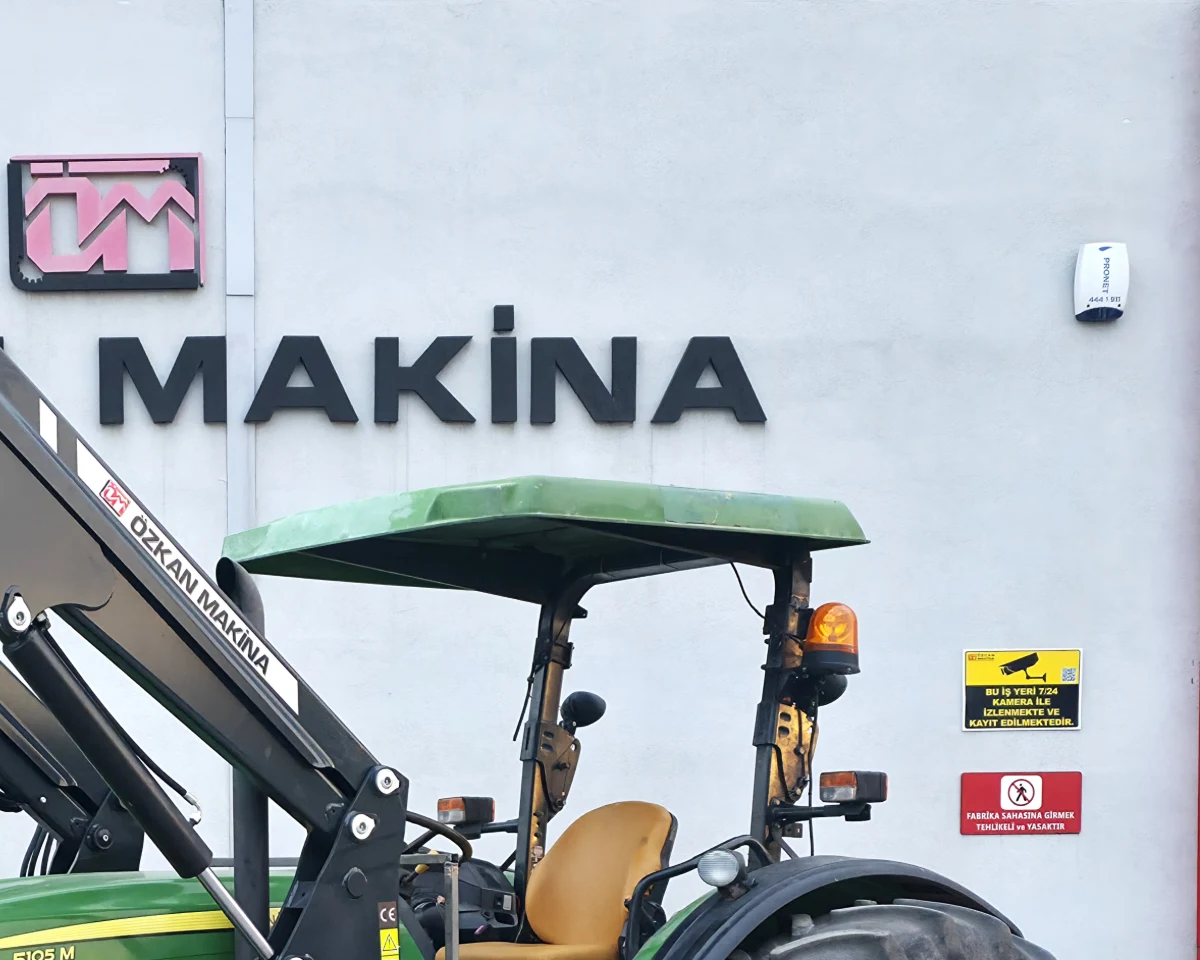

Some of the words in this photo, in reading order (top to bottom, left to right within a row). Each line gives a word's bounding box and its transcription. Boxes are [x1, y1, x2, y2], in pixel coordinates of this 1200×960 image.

[1102, 257, 1111, 294] PRONET
[98, 304, 768, 425] MAKİNA
[130, 514, 199, 595] ÖZKAN
[196, 589, 270, 677] MAKİNA
[985, 688, 1000, 696] BU
[1001, 686, 1012, 697] İŞ
[1013, 686, 1037, 696] YERİ
[1038, 687, 1059, 696] 7/24
[992, 698, 1034, 706] KAMERA
[1035, 696, 1052, 706] İLE
[983, 707, 1045, 717] İZLENMEKTE
[1046, 708, 1060, 716] VE
[969, 719, 999, 727] KAYIT
[1000, 717, 1074, 727] EDİLMEKTEDİR.
[966, 811, 1000, 820] FABRİKA
[1001, 811, 1043, 820] SAHASINA
[1044, 811, 1075, 819] GİRMEK
[59, 945, 76, 960] M
